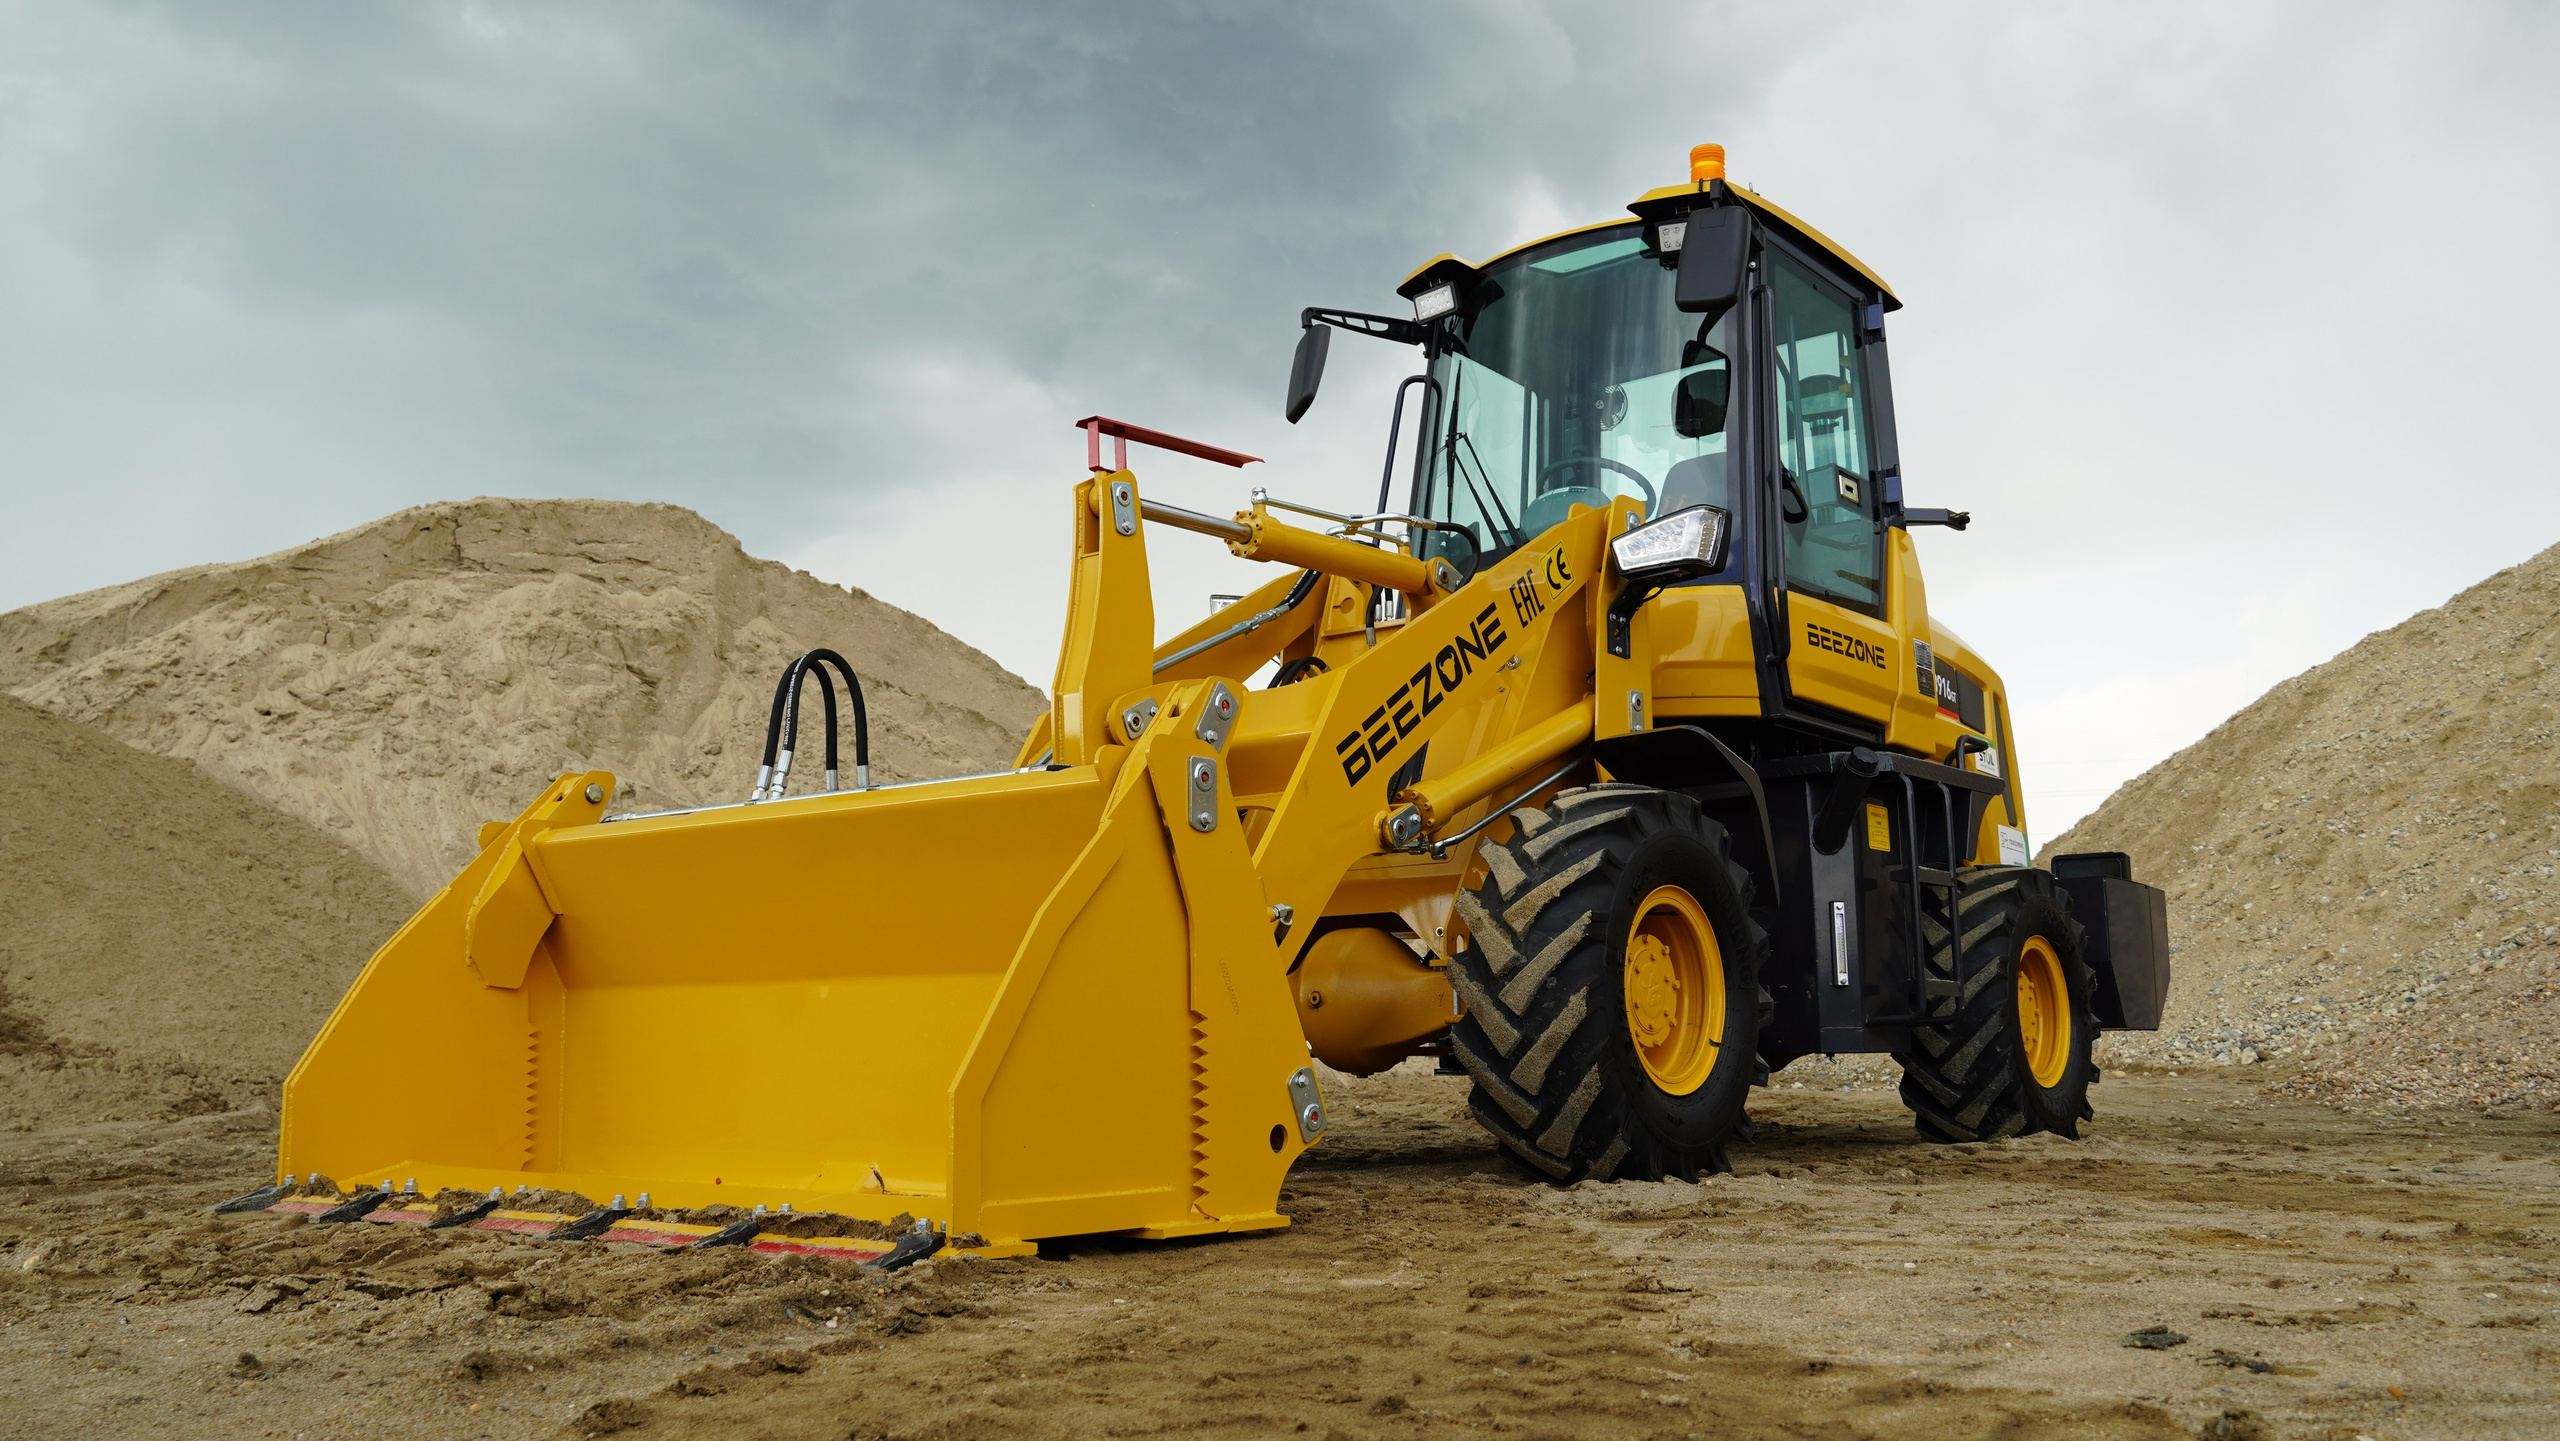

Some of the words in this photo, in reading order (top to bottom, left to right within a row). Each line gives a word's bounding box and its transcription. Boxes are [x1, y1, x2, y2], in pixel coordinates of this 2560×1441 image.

[1546, 547, 1572, 590] CE
[1807, 623, 1886, 669] BEEZONE
[1336, 601, 1507, 788] BEEZONE
